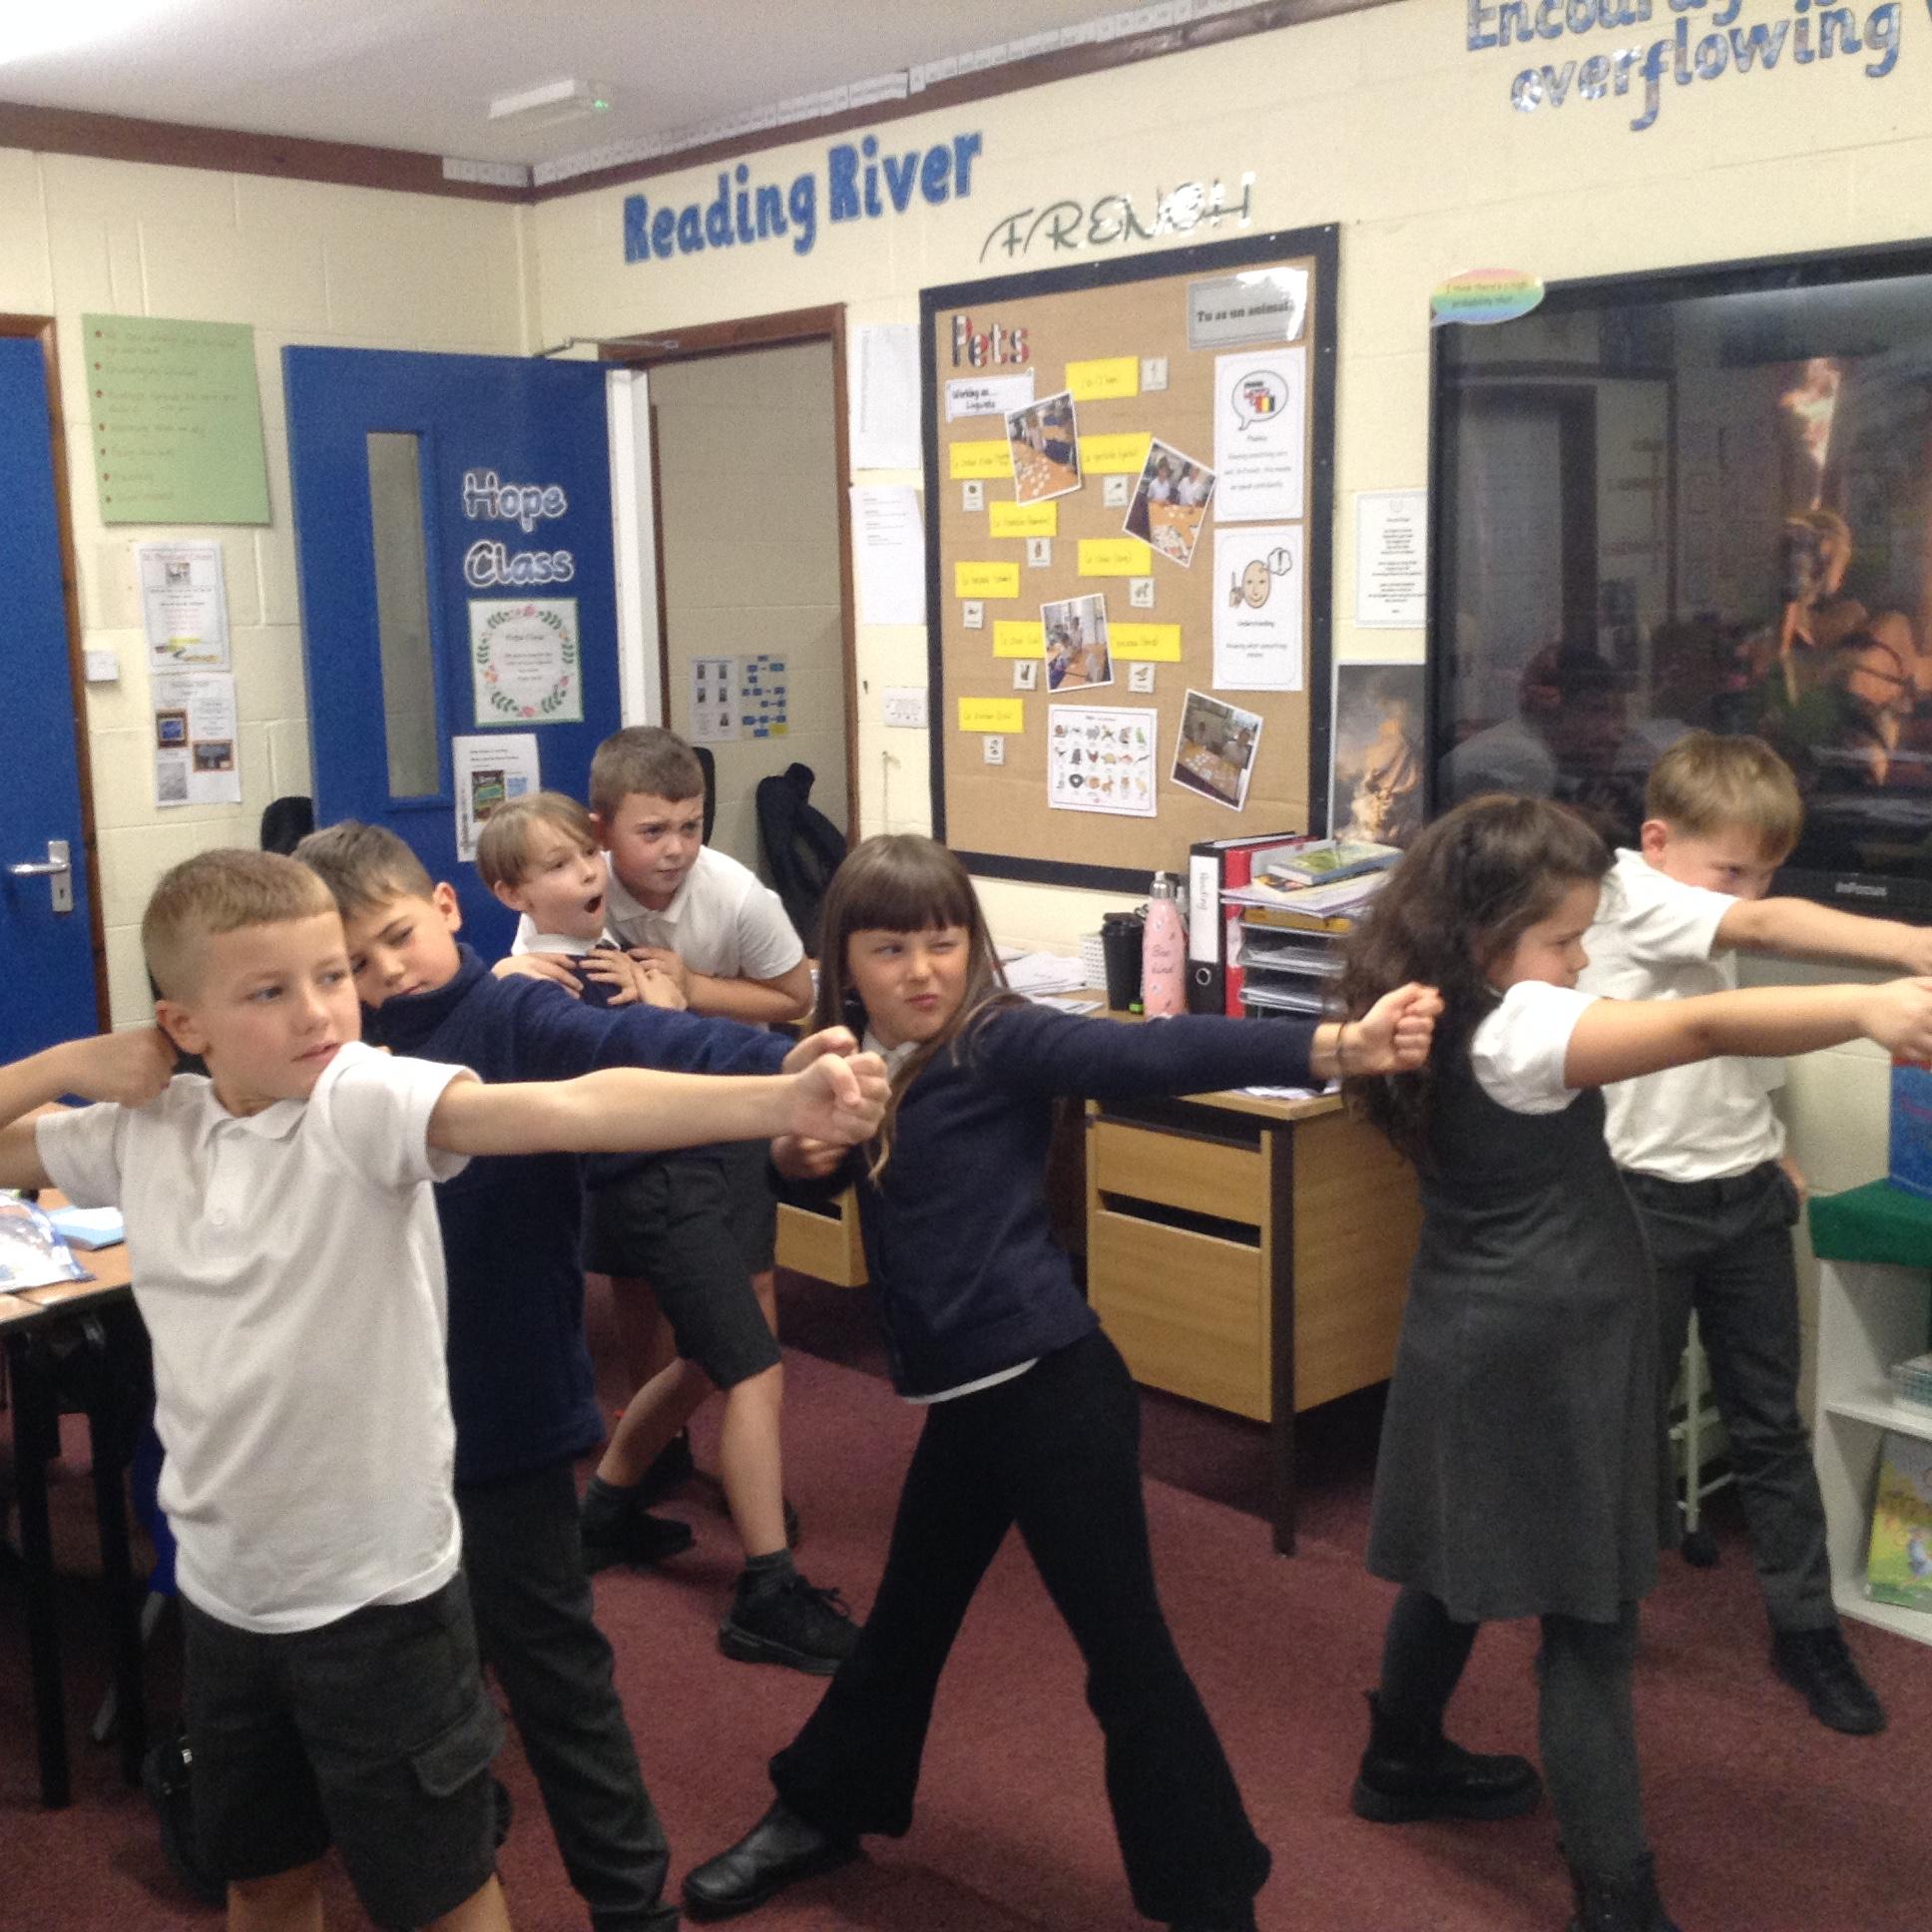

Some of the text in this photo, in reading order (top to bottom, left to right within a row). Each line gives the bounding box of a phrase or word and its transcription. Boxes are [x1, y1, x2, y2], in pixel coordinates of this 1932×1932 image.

[1511, 0, 1900, 132] overflowing
[623, 132, 982, 265] Reading River
[979, 171, 1255, 262] FRENCH
[951, 315, 1030, 367] Pets
[463, 471, 567, 533] Hope
[463, 540, 575, 589] Class
